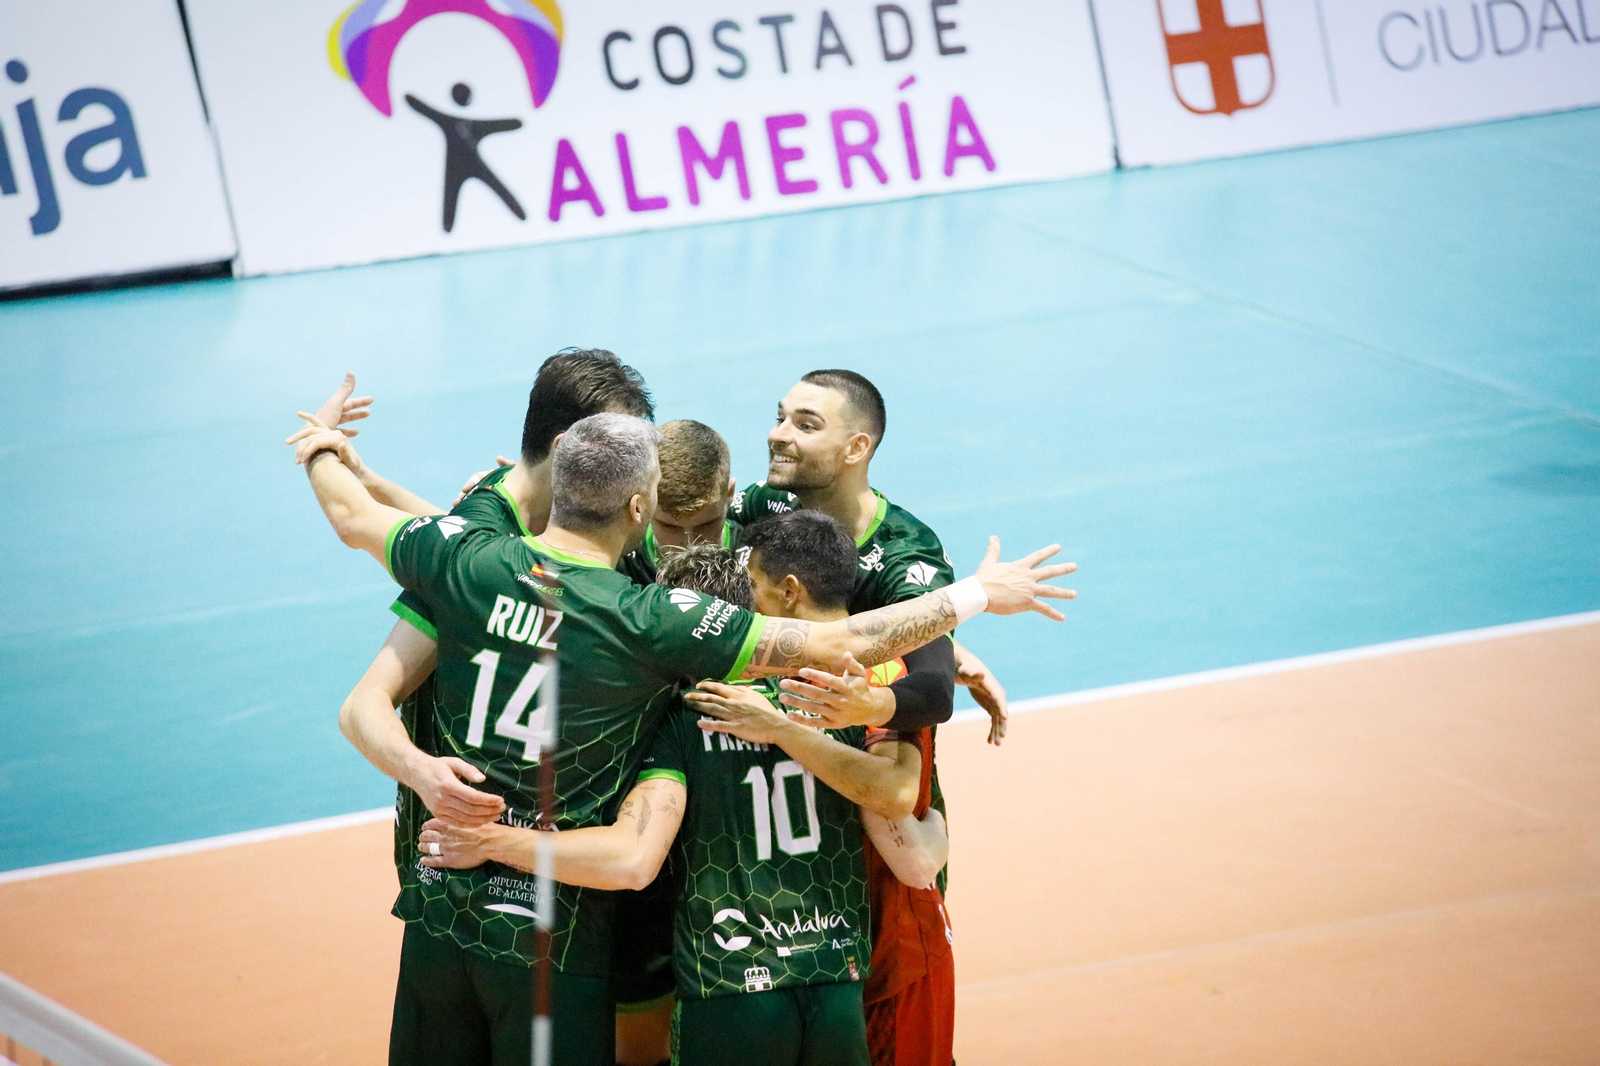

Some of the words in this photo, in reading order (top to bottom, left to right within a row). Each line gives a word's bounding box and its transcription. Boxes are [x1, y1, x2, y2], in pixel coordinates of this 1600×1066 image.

[602, 9, 853, 90] COSTA
[876, 0, 966, 61] DE
[549, 74, 997, 222] ALMERÍA
[487, 594, 563, 650] RUIZ
[466, 648, 556, 762] 14
[741, 759, 821, 861] 10
[488, 886, 501, 897] DE
